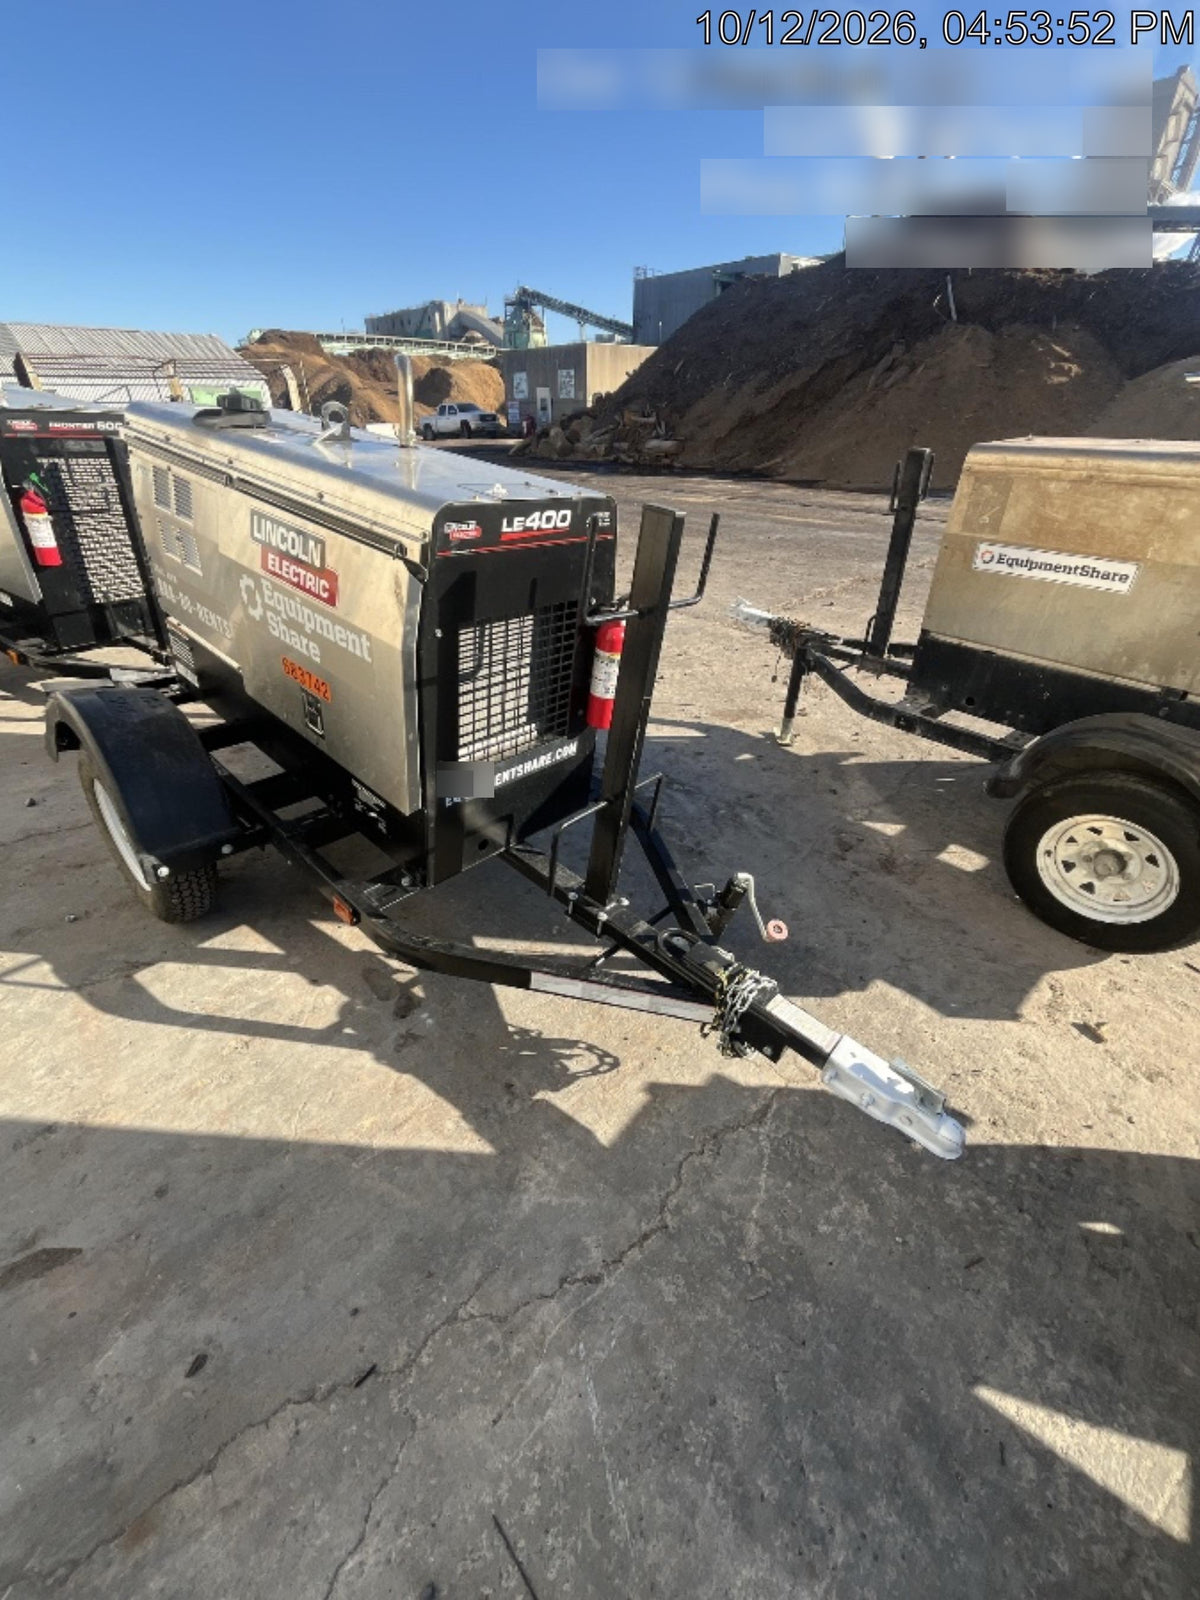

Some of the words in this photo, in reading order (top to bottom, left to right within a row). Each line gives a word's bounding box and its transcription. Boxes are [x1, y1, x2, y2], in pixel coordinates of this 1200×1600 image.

[253, 514, 322, 568] LINCOLN
[502, 509, 571, 532] LE400
[267, 552, 330, 598] ELECTRIC
[996, 552, 1130, 583] EquipmentShare
[261, 578, 372, 663] Equipment
[267, 611, 321, 664] Share
